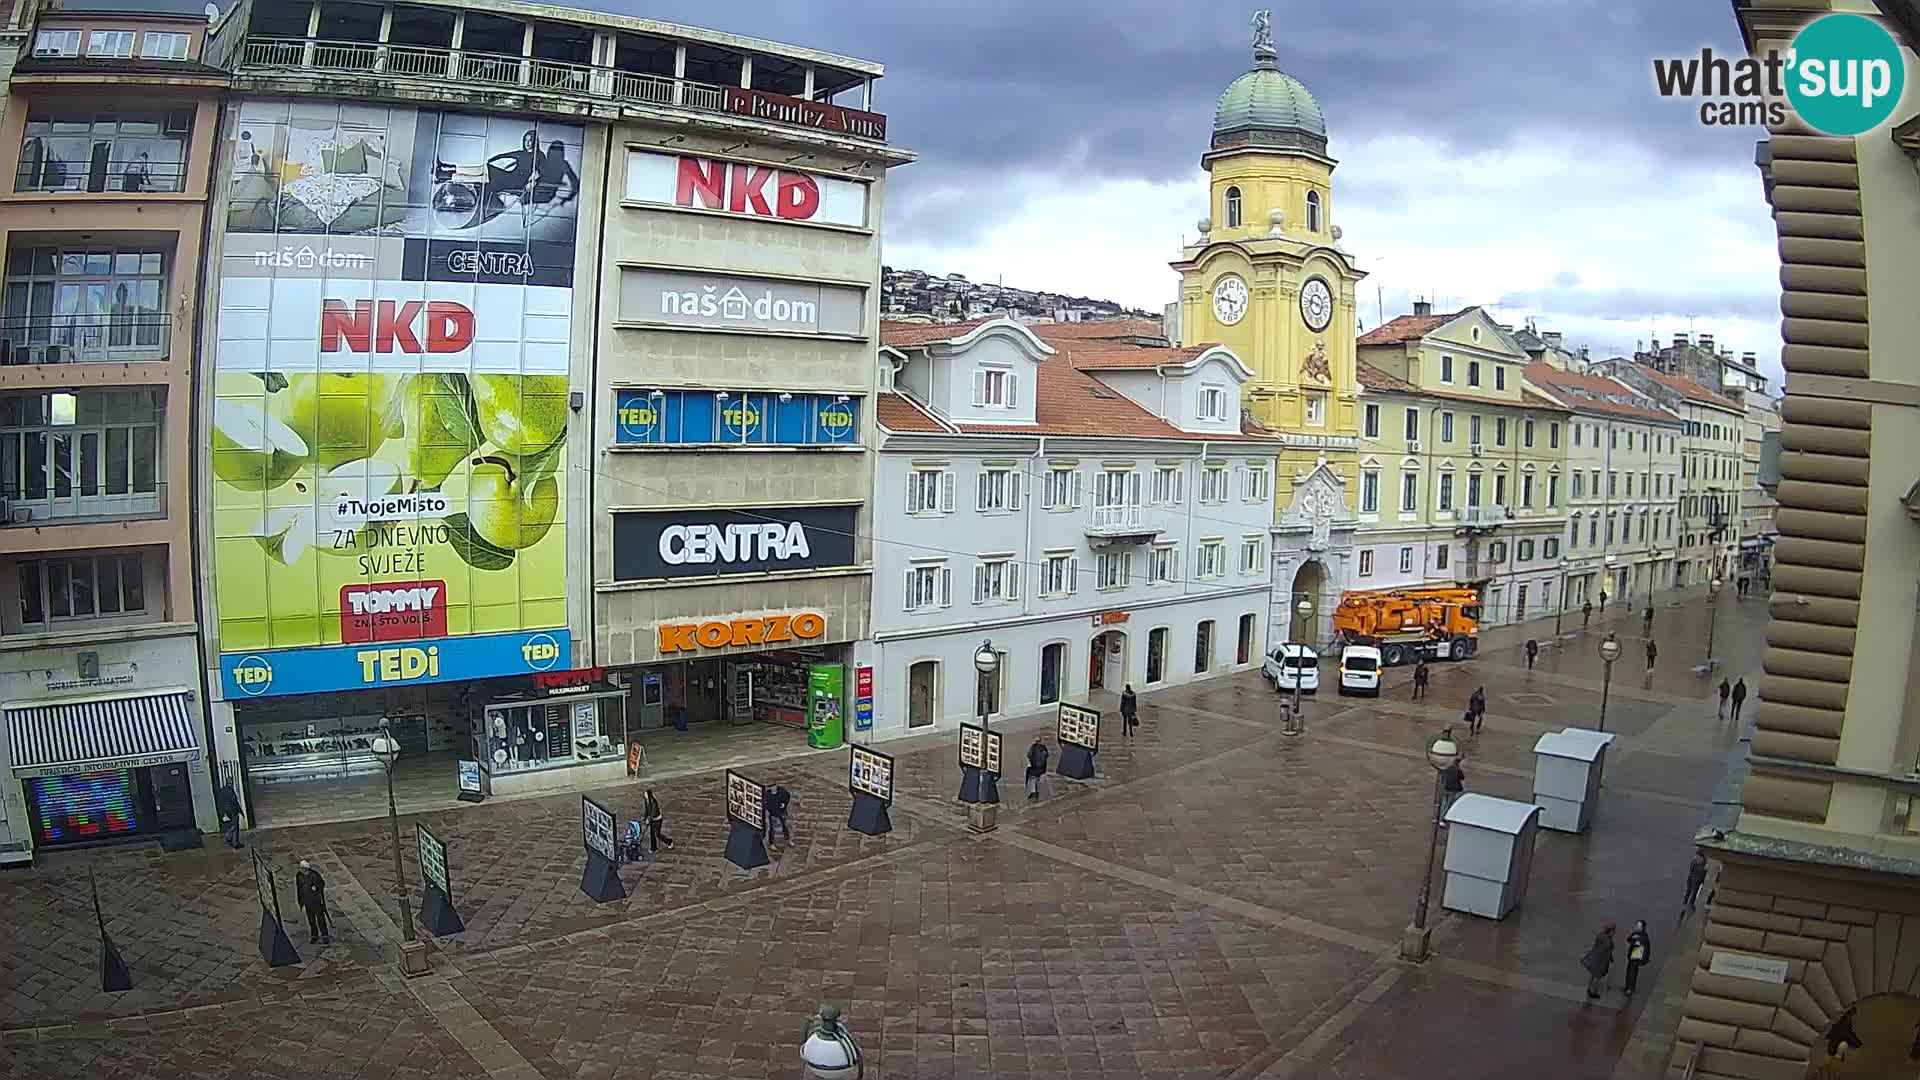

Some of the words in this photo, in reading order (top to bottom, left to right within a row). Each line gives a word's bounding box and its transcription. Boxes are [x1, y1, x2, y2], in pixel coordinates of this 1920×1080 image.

[722, 89, 745, 112] Le
[675, 156, 820, 220] NKD
[254, 245, 294, 268] naš
[318, 247, 366, 270] dom
[447, 250, 534, 276] CENTRA
[660, 286, 716, 317] naš
[753, 290, 816, 323] dom
[320, 299, 476, 354] NKD
[619, 408, 657, 426] TEDi
[723, 409, 759, 427] TEDi
[820, 411, 853, 427] TEDi
[338, 498, 446, 517] #TvojeMisto
[333, 529, 357, 549] ZA
[367, 524, 450, 548] DNEVNO
[659, 521, 810, 565] CENTRA
[359, 548, 426, 575] SVJEŽE
[348, 587, 439, 615] TOMMY
[659, 613, 825, 653] KORZO
[357, 646, 440, 683] TEDi
[522, 644, 560, 661] TEDi
[233, 666, 273, 685] TEDi
